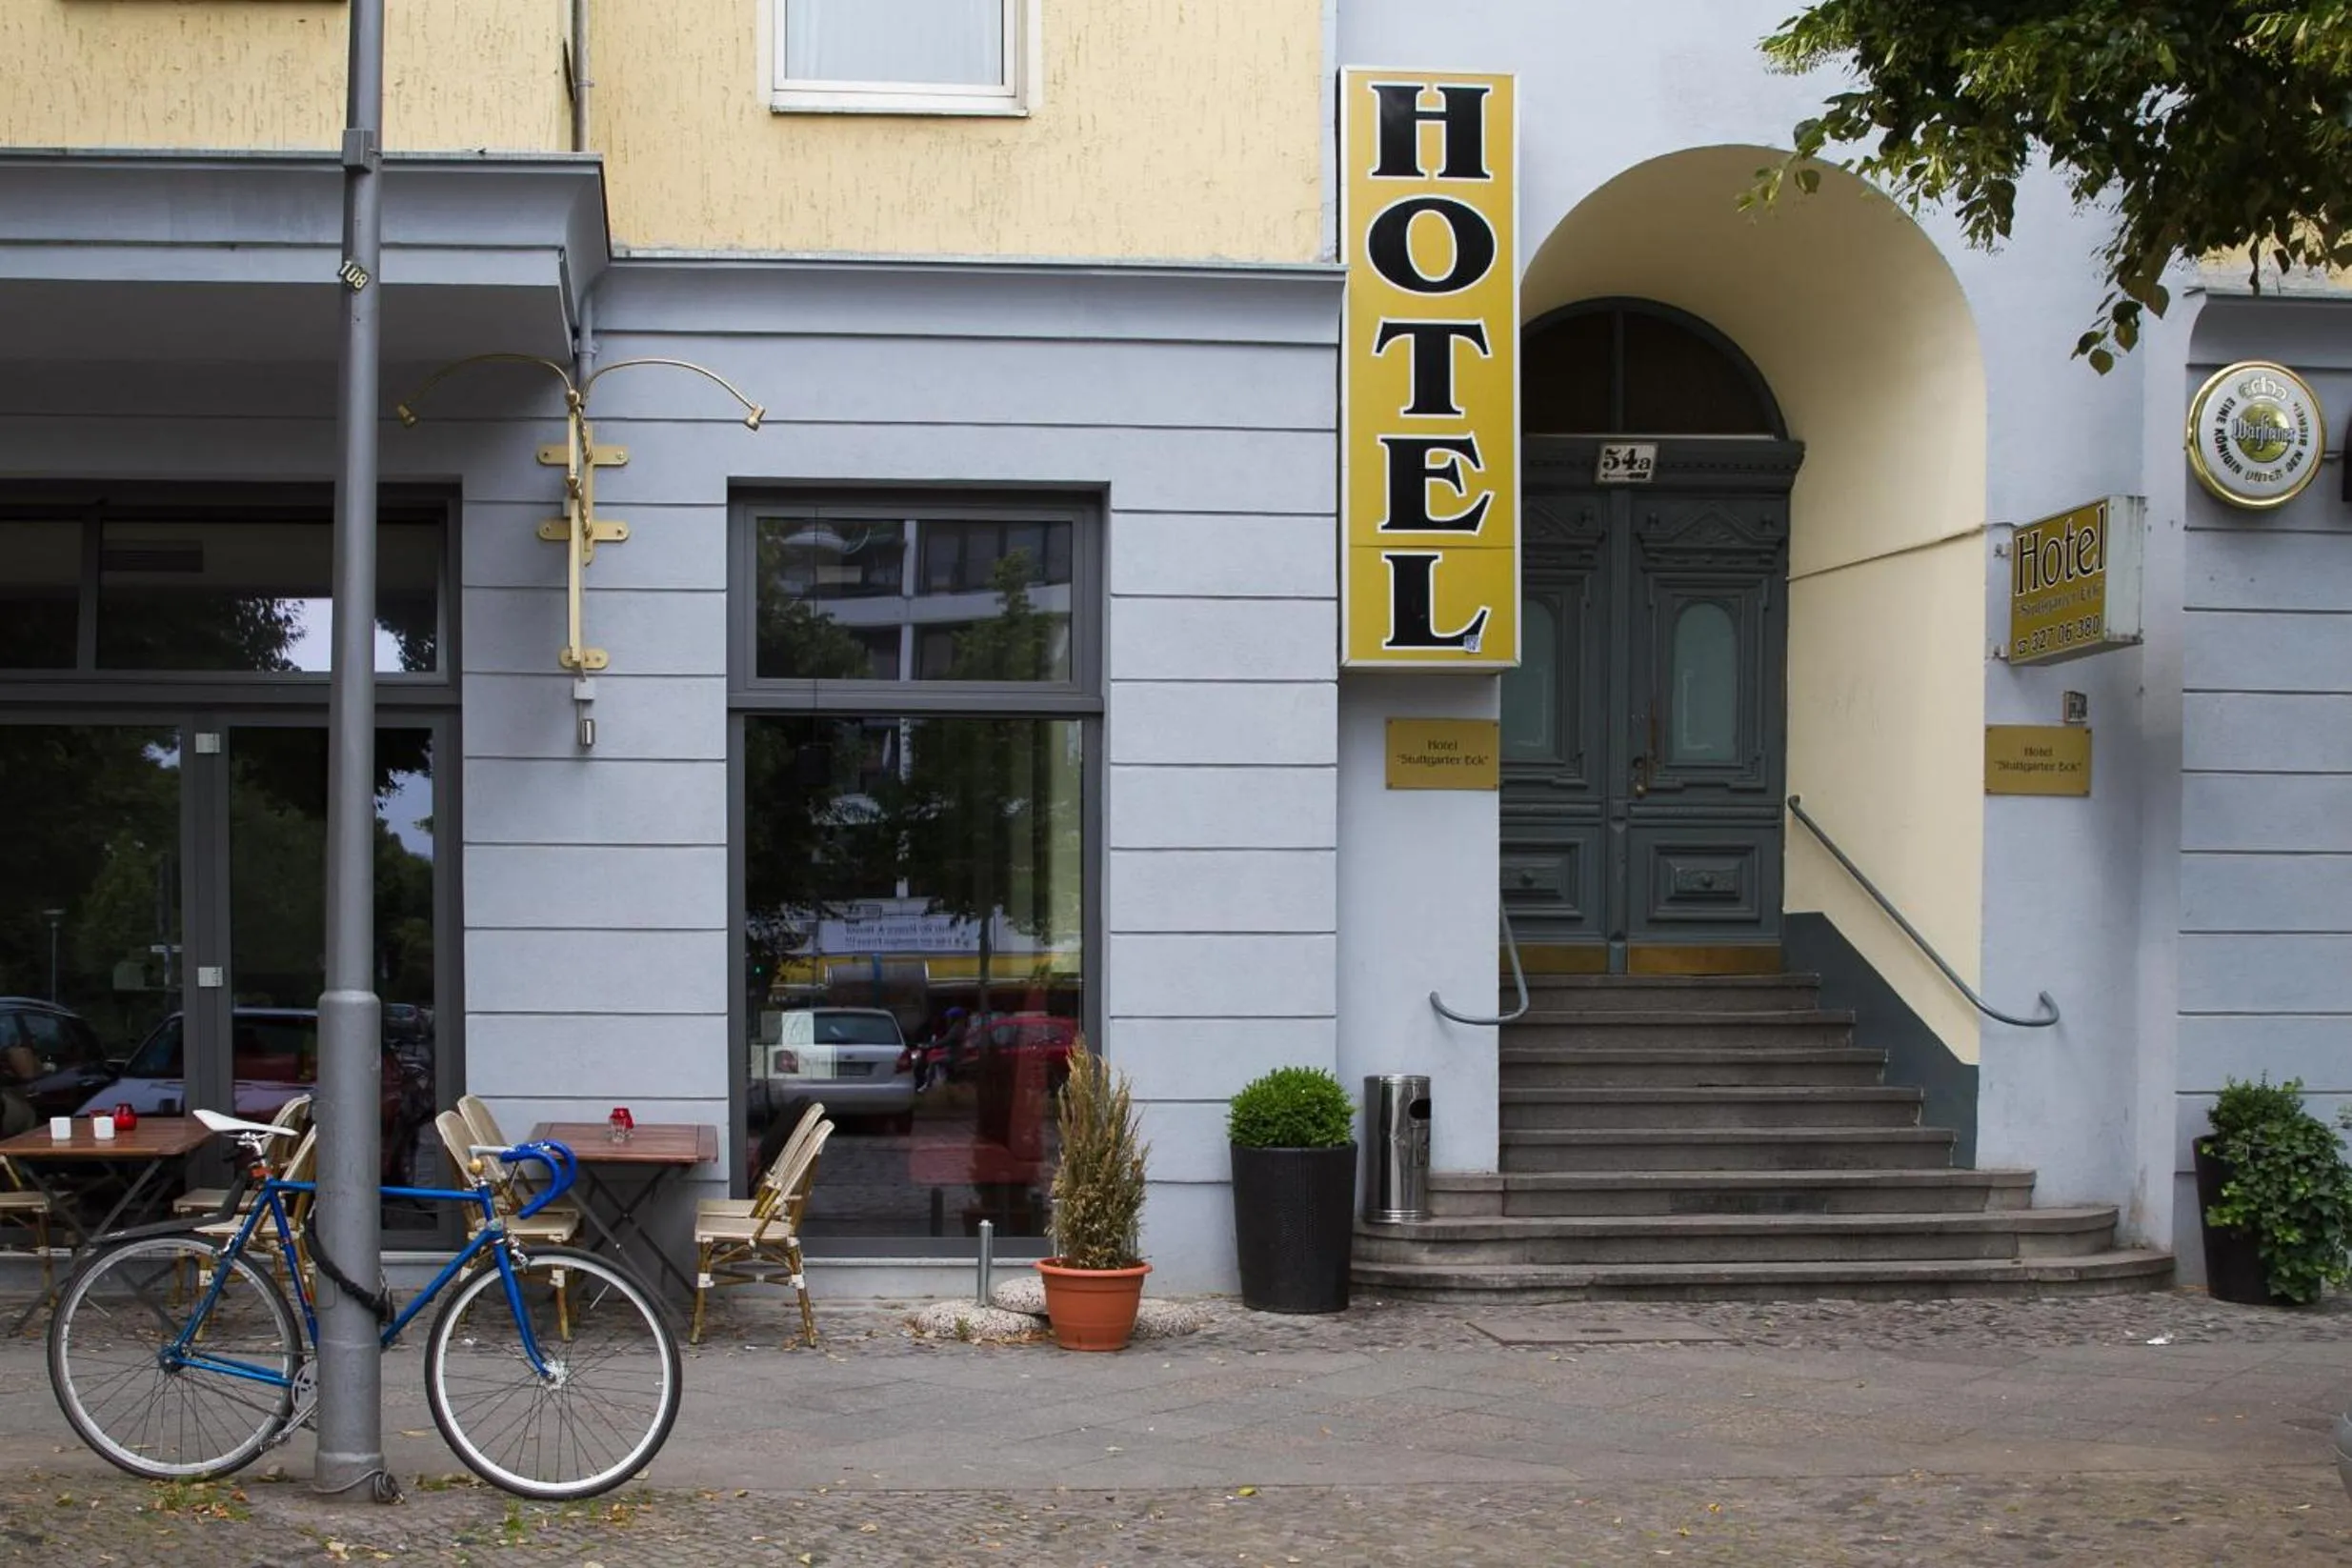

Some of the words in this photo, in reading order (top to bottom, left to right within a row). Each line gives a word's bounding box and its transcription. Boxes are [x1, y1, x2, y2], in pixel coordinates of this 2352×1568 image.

[340, 260, 368, 289] 108
[1365, 80, 1498, 651] HOTEL
[2215, 395, 2237, 424] EINE
[1602, 448, 1652, 471] 54a
[2213, 428, 2243, 475] KÖNIGIN
[2286, 449, 2304, 472] DEN
[2015, 504, 2106, 596] Hotel
[2058, 620, 2075, 645] 06
[2076, 613, 2101, 639] 380
[1427, 739, 1458, 751] Hotel
[2023, 746, 2054, 757] Hotel
